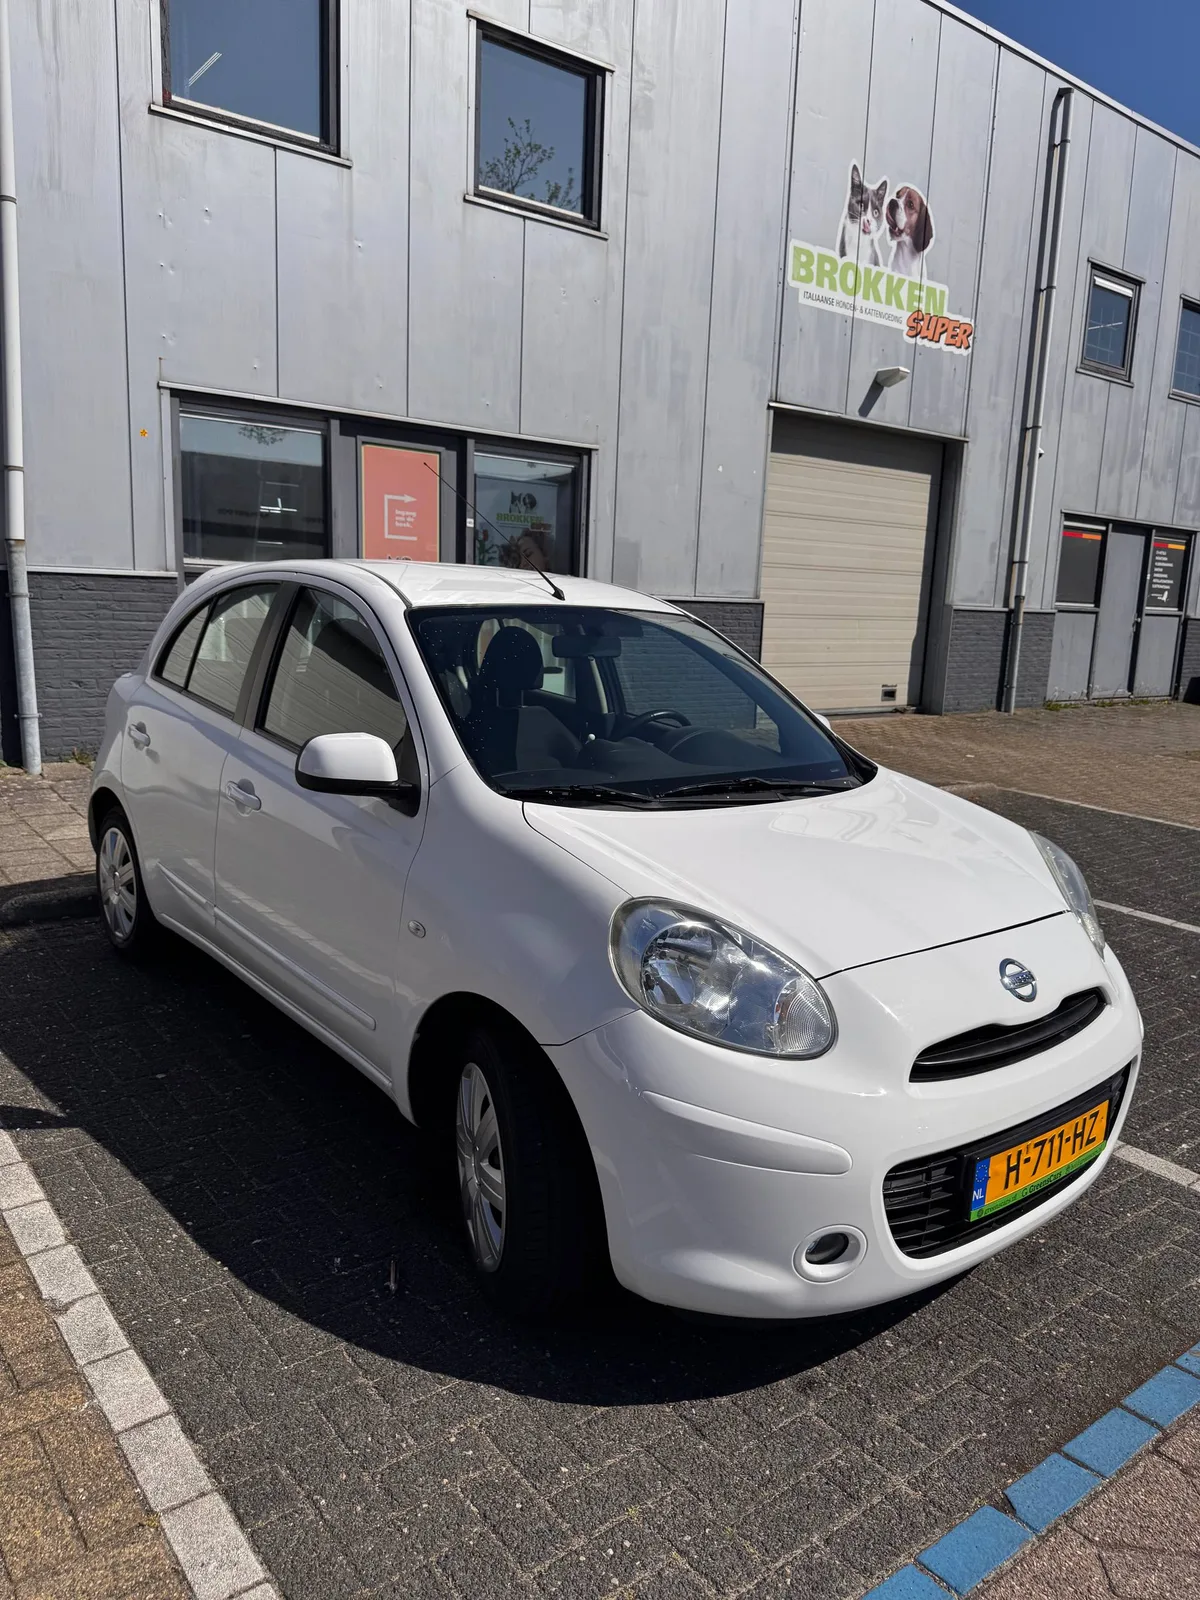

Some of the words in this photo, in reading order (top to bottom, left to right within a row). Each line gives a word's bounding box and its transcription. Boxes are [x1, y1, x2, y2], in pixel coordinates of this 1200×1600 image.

[792, 245, 946, 317] BROKKEN
[803, 290, 835, 306] ITALIAANSE
[864, 307, 903, 325] KATTENVOEDING
[906, 310, 973, 350] SUPER
[1004, 1109, 1100, 1190] H-711-HZ
[972, 1188, 984, 1202] NL
[1029, 1173, 1062, 1193] GreensCars
